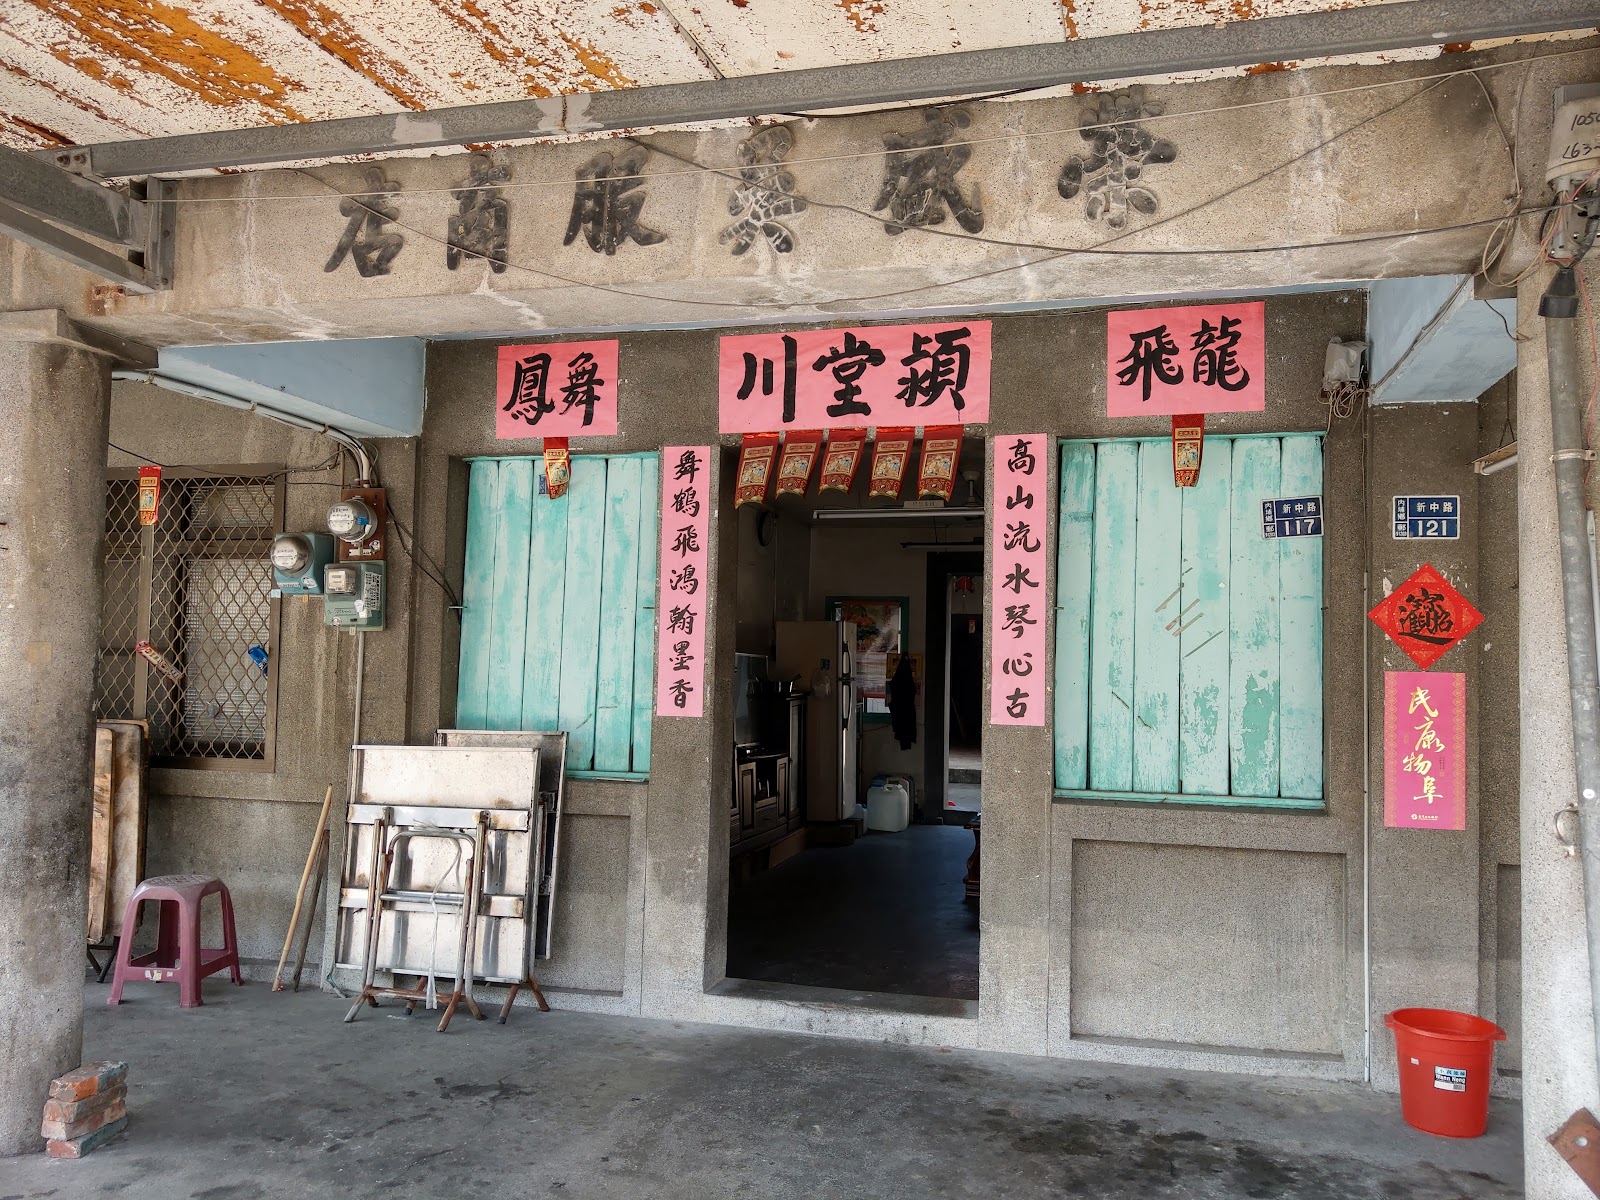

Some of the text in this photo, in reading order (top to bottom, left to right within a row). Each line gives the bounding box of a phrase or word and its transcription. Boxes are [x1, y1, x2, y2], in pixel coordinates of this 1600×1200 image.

[1283, 502, 1316, 513] 新中路
[1416, 501, 1453, 513] 新中路
[1284, 518, 1315, 536] 117
[1417, 519, 1447, 536] 121
[666, 449, 702, 708] 舞鶴飛鴻翰墨香
[1002, 438, 1041, 718] 高山流水琴心古
[1402, 686, 1446, 804] 民康物阜
